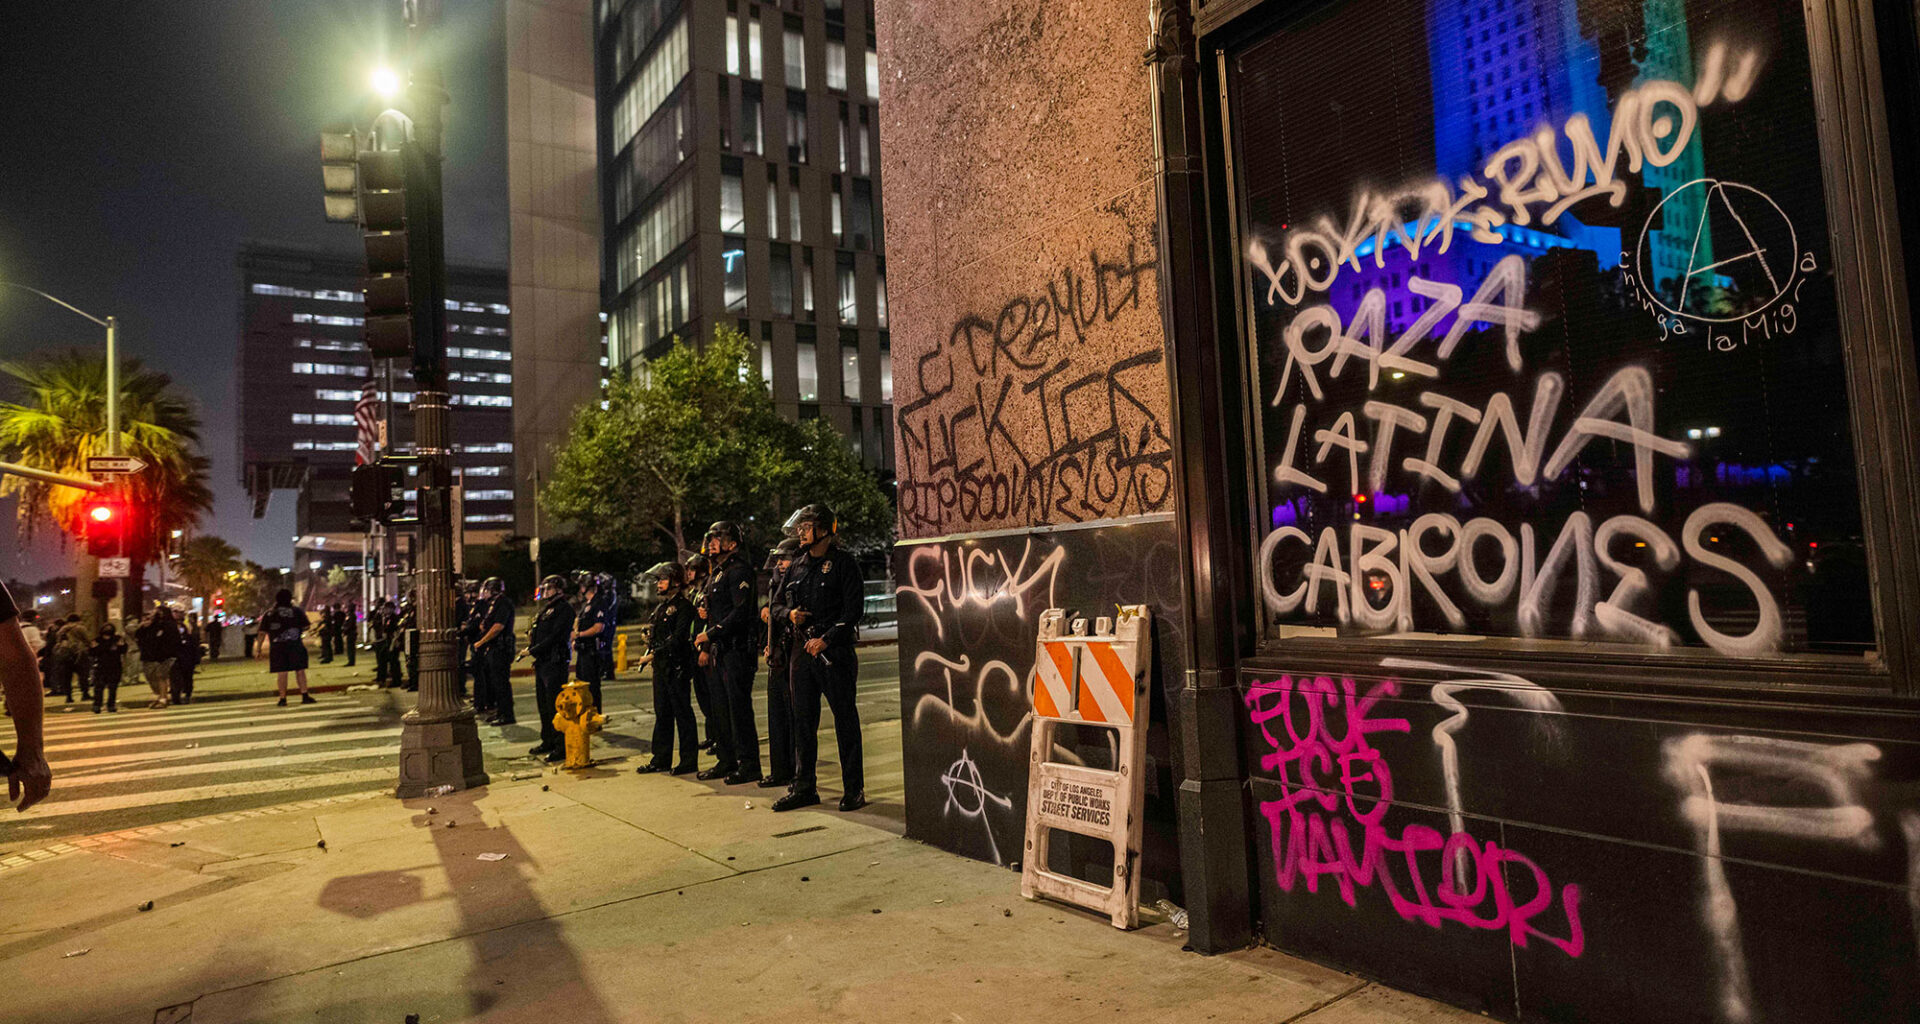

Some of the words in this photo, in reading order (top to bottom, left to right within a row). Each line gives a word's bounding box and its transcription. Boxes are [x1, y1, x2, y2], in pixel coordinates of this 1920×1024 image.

[1272, 252, 1541, 408] RAZA
[1274, 365, 1693, 514] LATINA
[1260, 502, 1795, 658] CABRONES
[914, 650, 1035, 746] IC
[1041, 800, 1071, 817] STREET
[1070, 805, 1111, 826] SERVICES
[1067, 793, 1089, 806] PUBLIC
[1089, 797, 1111, 811] WORKS
[1069, 784, 1079, 794] LOS
[1079, 786, 1103, 799] ANGELES
